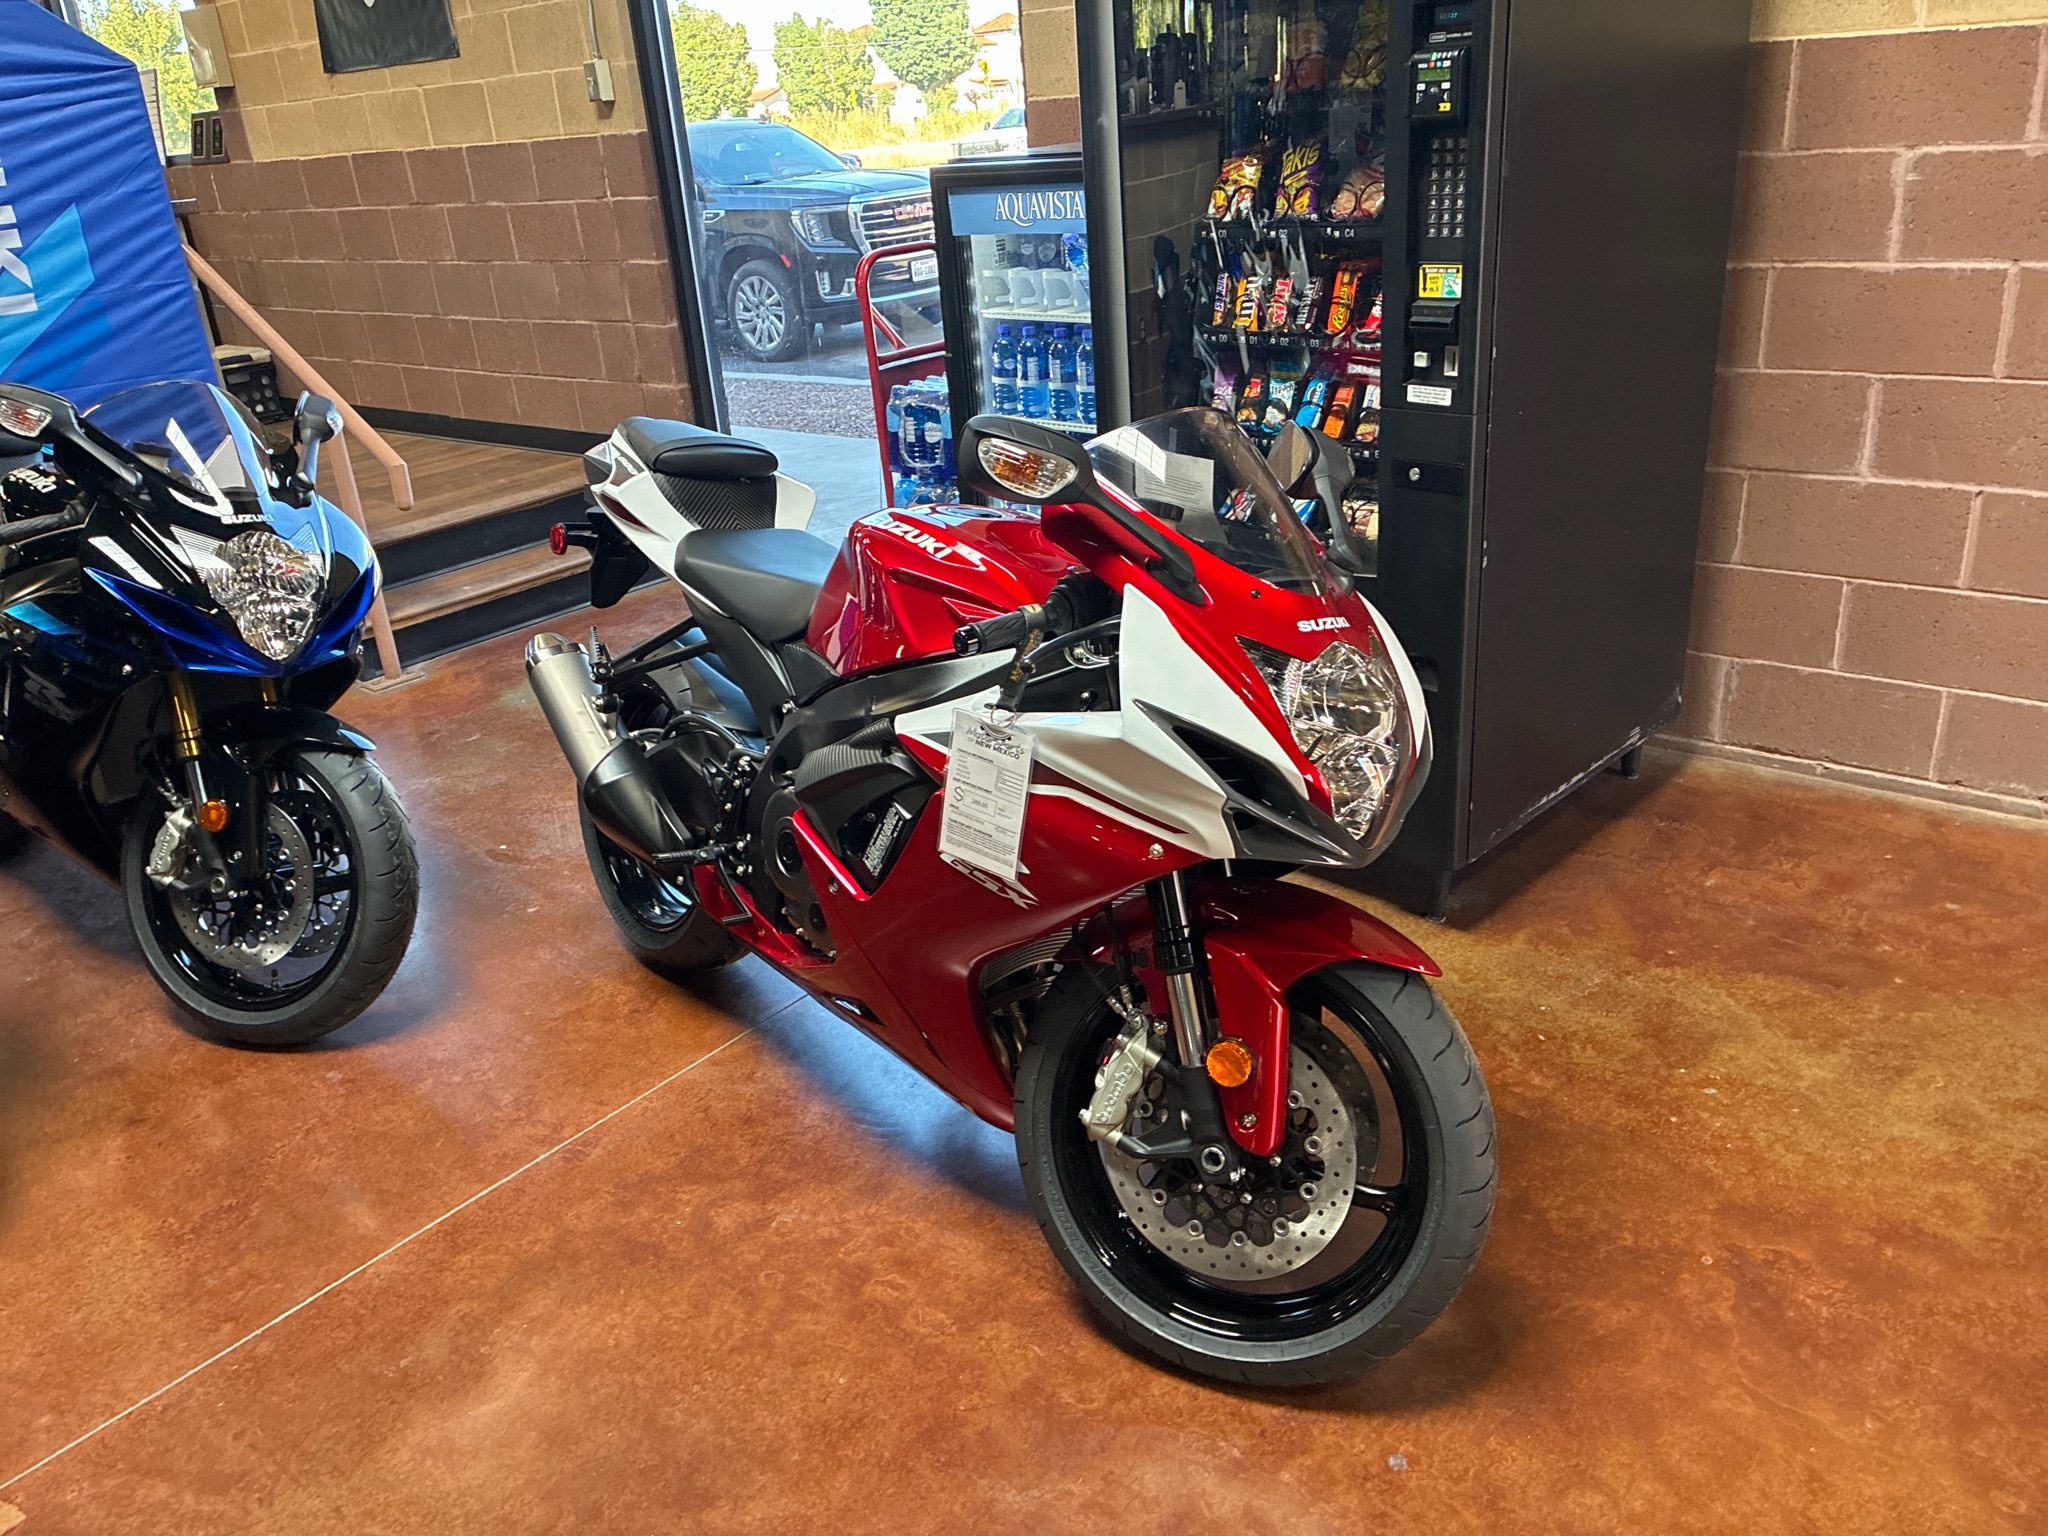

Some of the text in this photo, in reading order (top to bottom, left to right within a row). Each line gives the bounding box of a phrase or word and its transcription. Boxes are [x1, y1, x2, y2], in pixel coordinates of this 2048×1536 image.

[894, 202, 933, 220] GMC
[995, 190, 1084, 227] AQUAVISTA
[221, 513, 275, 525] SUZUKI
[1297, 616, 1351, 632] SUZUKI
[975, 739, 992, 750] NEW
[992, 744, 1021, 760] MEXICO
[953, 785, 964, 803] $
[1096, 1062, 1134, 1123] brembo
